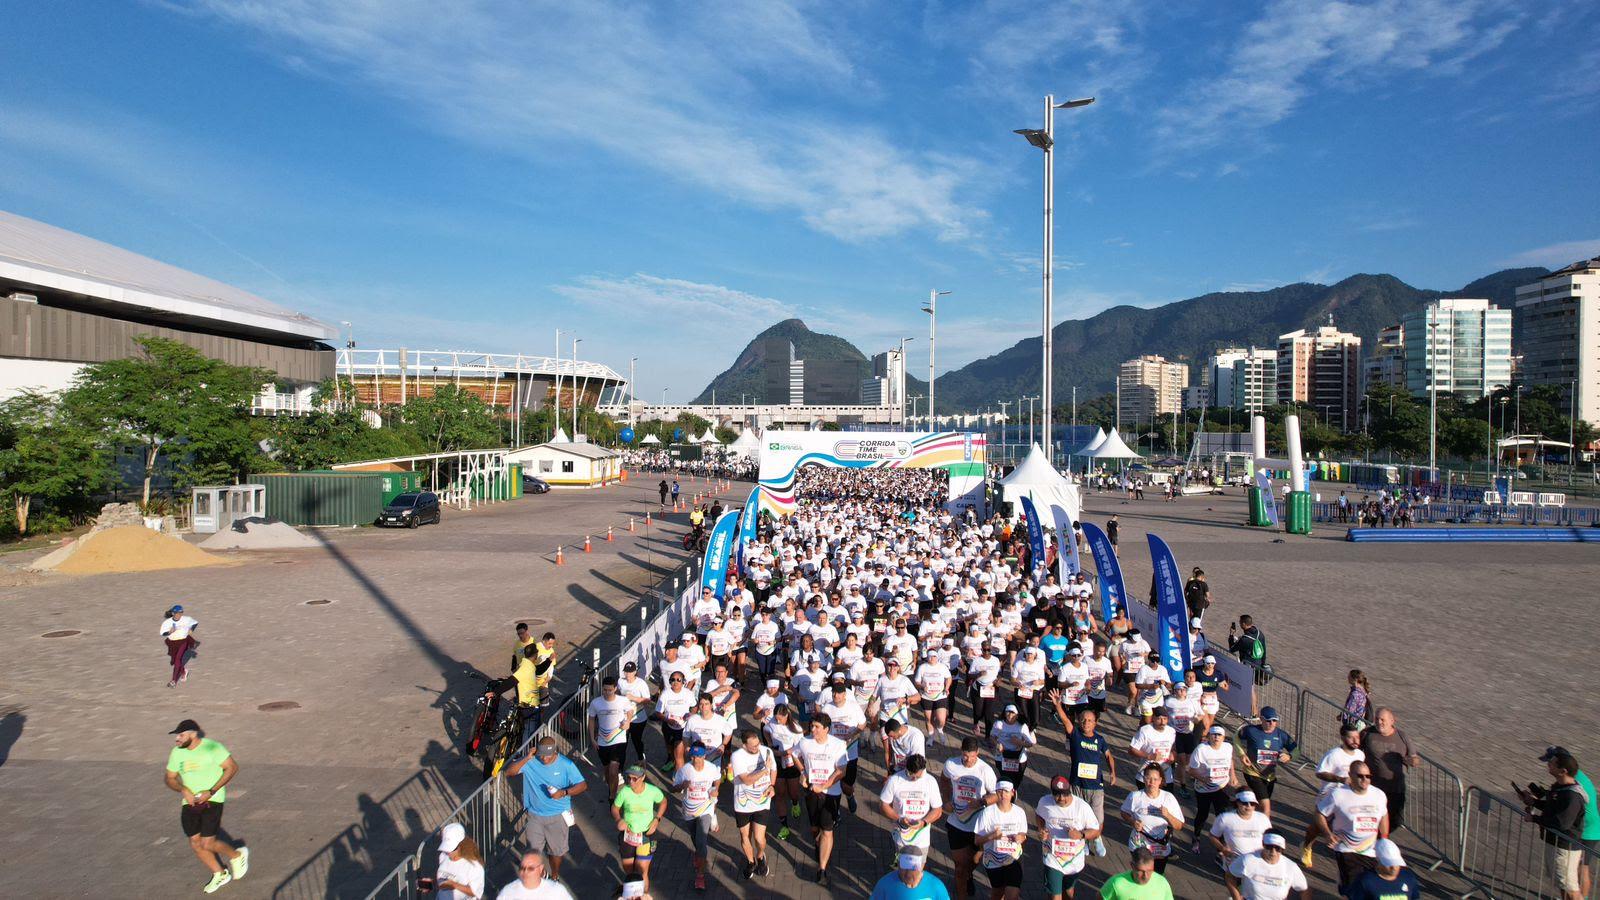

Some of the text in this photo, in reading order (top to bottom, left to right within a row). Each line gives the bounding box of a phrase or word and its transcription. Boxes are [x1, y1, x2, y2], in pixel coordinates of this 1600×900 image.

[856, 452, 885, 460] BRASIL
[1095, 537, 1114, 578] BRASIL
[1160, 554, 1176, 605] BRASIL
[1168, 613, 1183, 672] CAIXA
